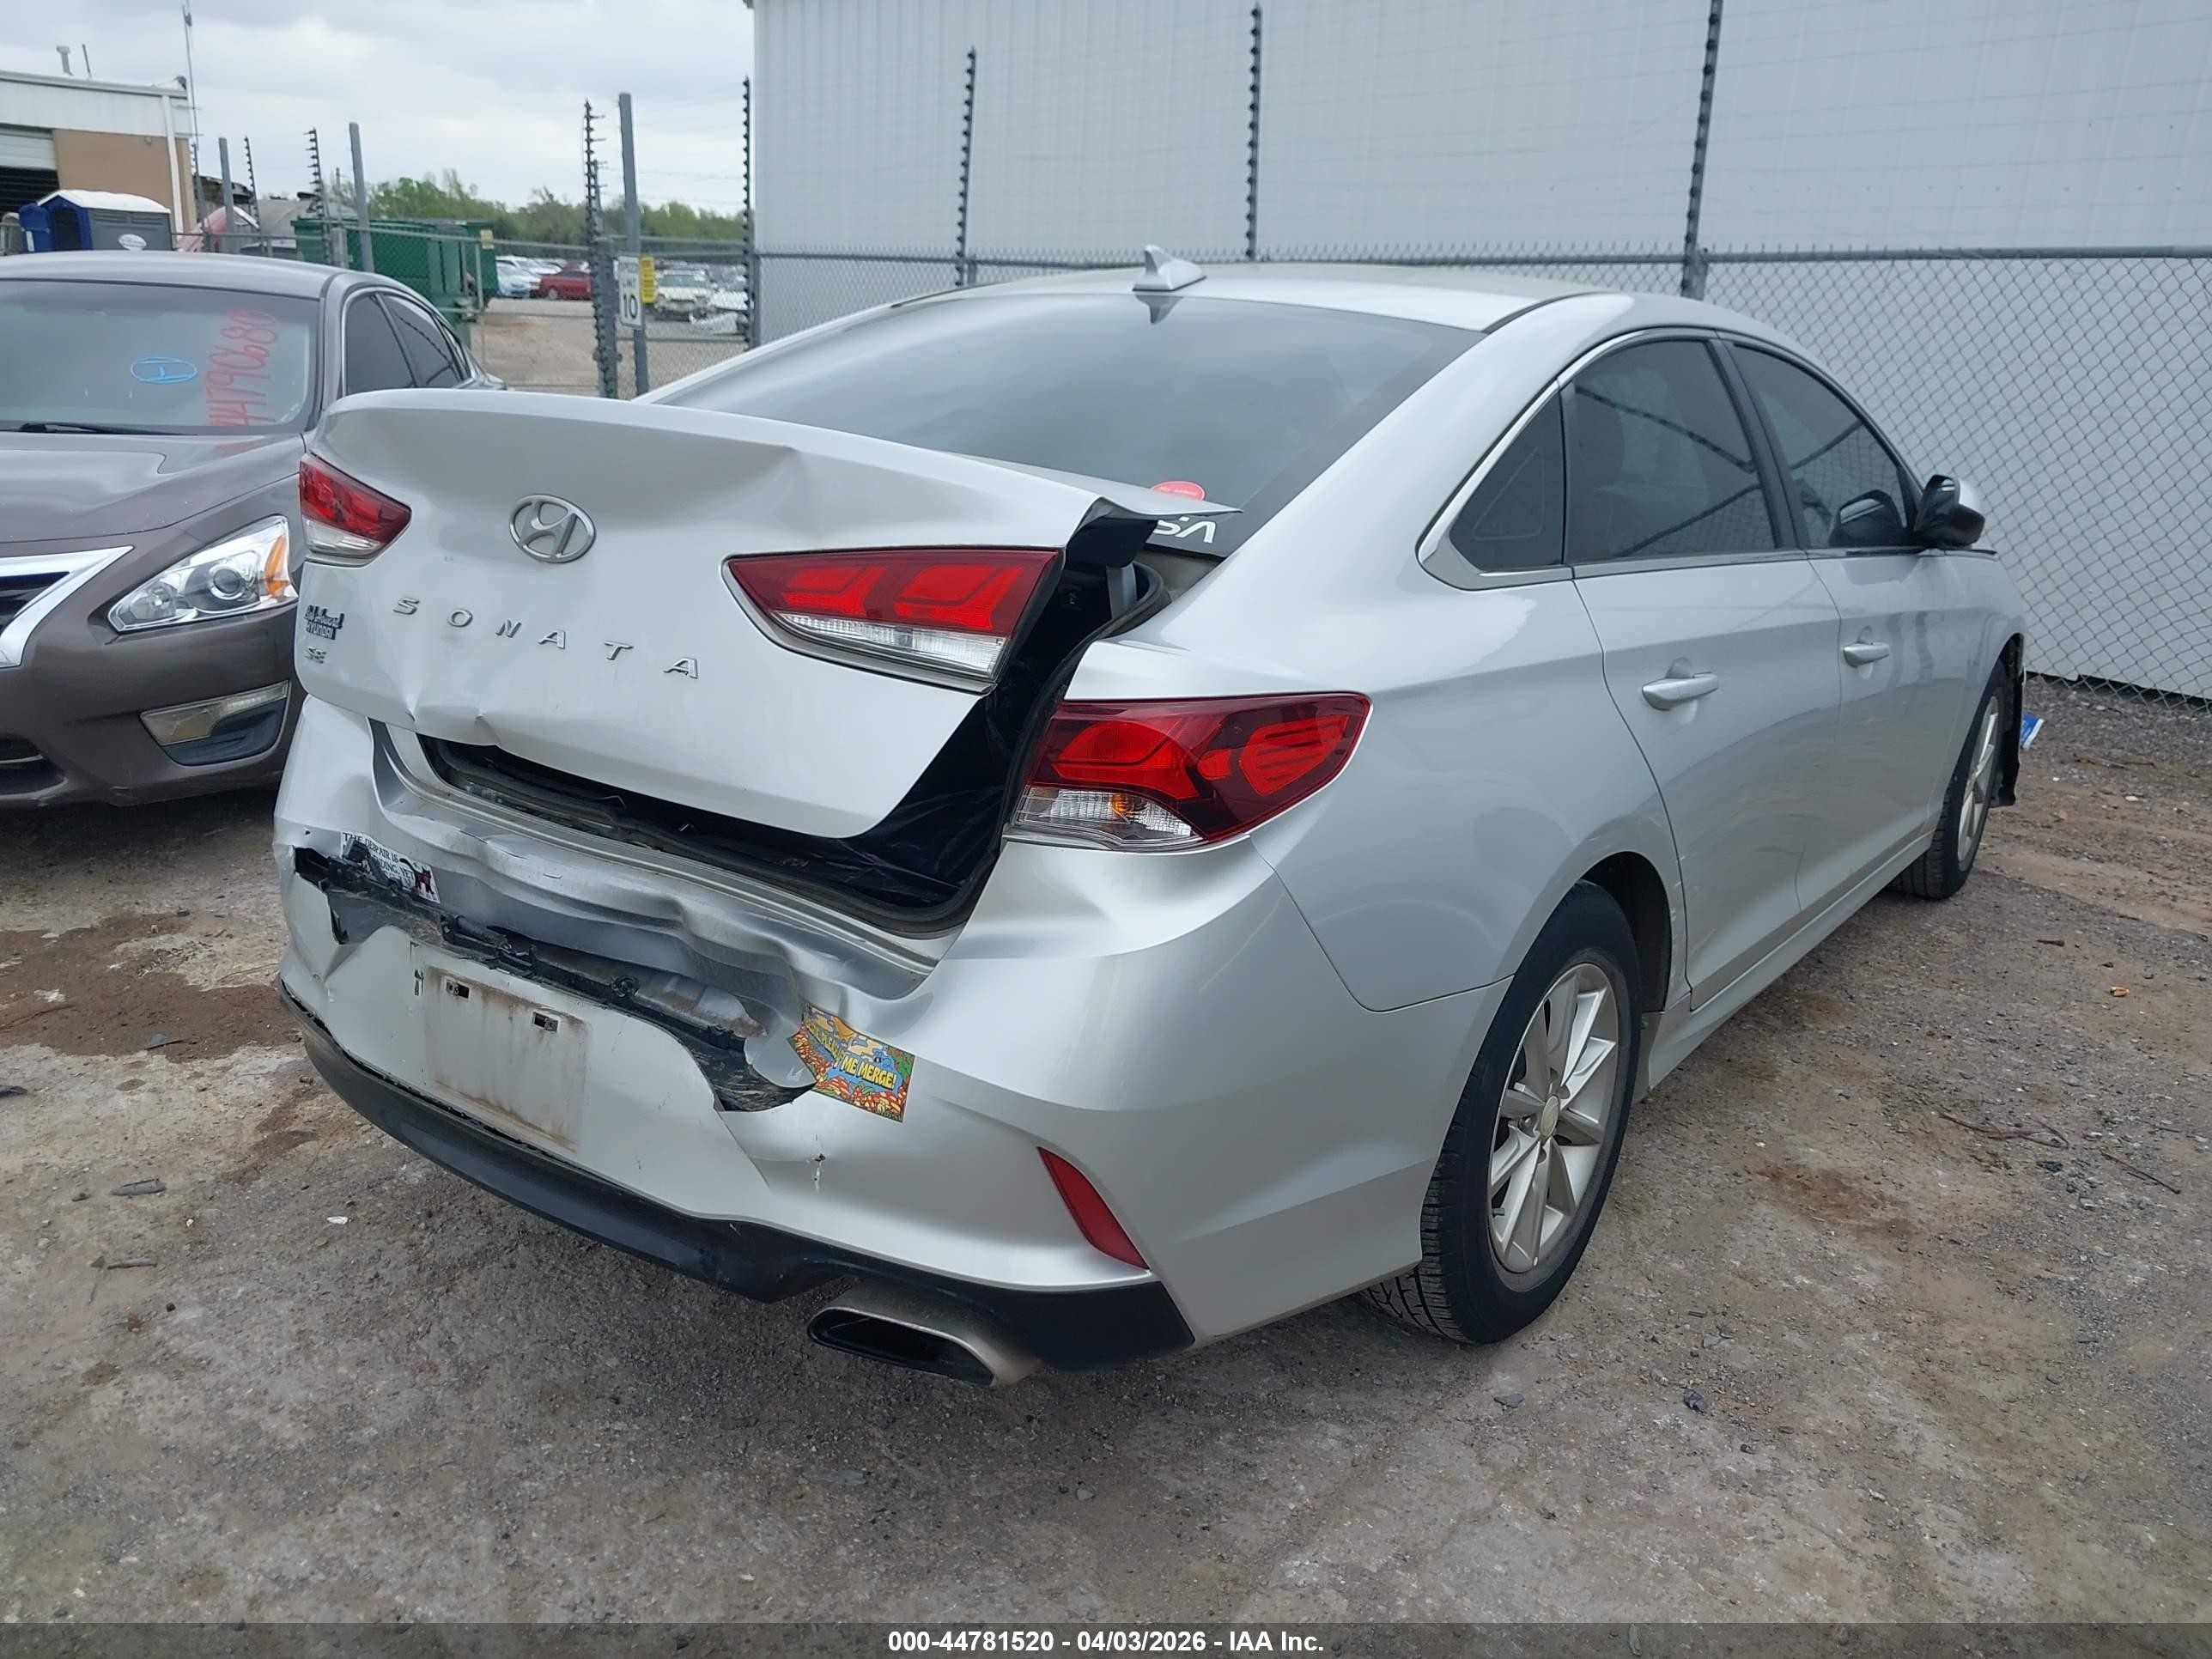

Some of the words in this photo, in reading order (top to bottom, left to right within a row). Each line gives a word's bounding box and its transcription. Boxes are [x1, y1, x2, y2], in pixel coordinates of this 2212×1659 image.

[623, 294, 639, 319] 10
[392, 597, 699, 679] SONATA
[841, 1056, 859, 1076] ME
[858, 1061, 898, 1091] MERGE!
